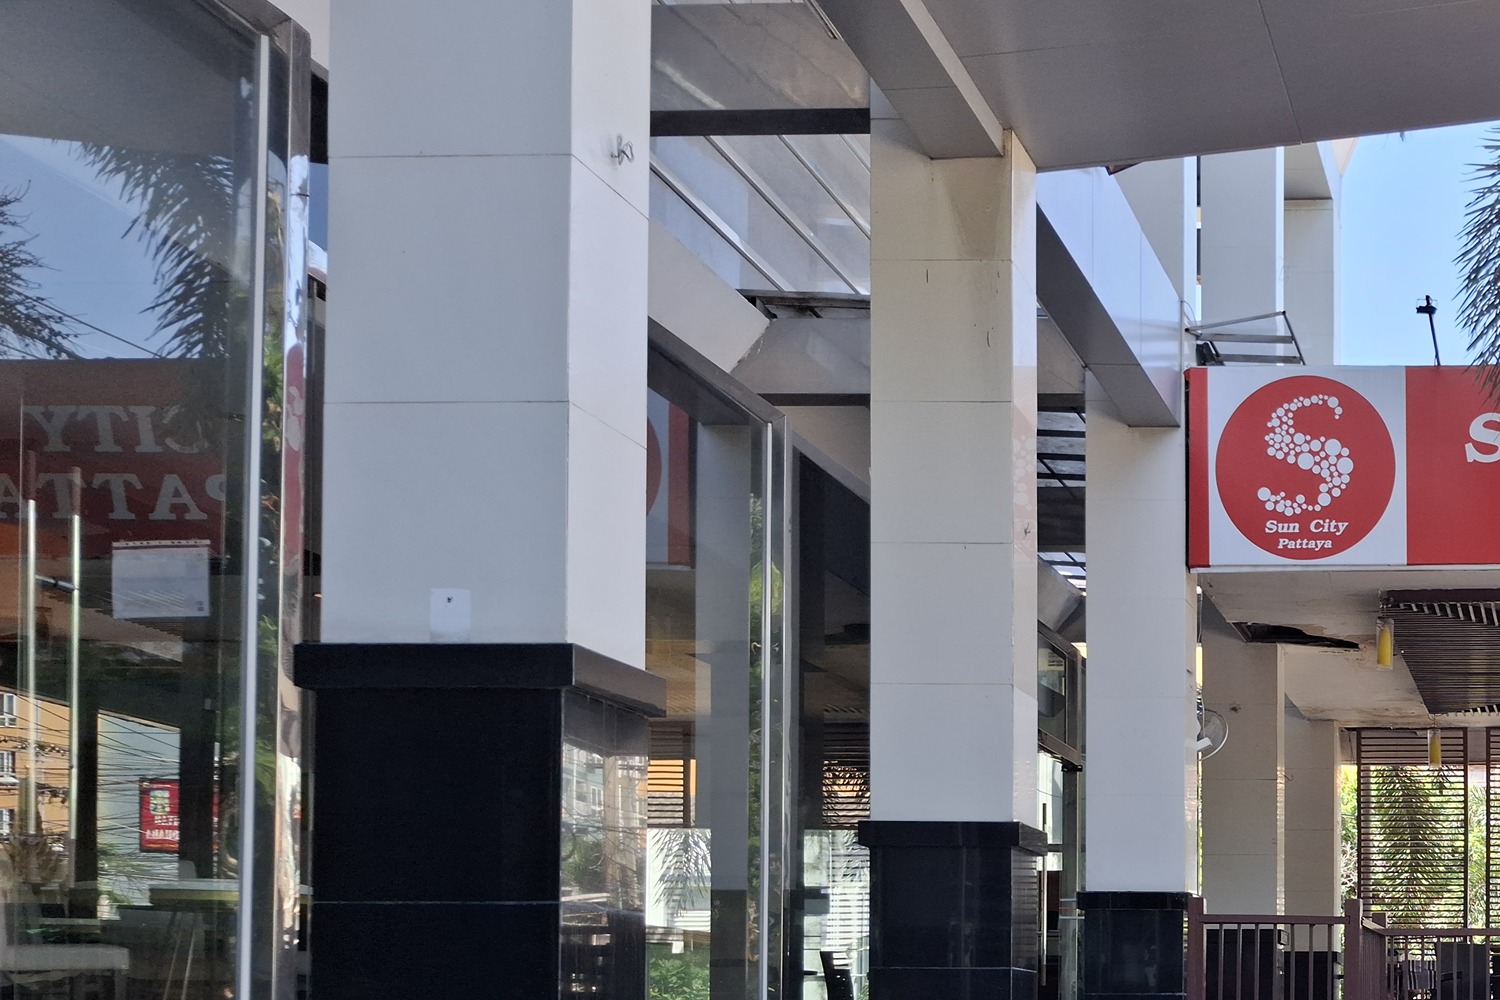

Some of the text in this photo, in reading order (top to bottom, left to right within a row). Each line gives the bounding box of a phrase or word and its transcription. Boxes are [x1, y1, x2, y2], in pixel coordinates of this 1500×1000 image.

[1265, 519, 1349, 536] Sun City
[1277, 538, 1332, 551] Pattaya
